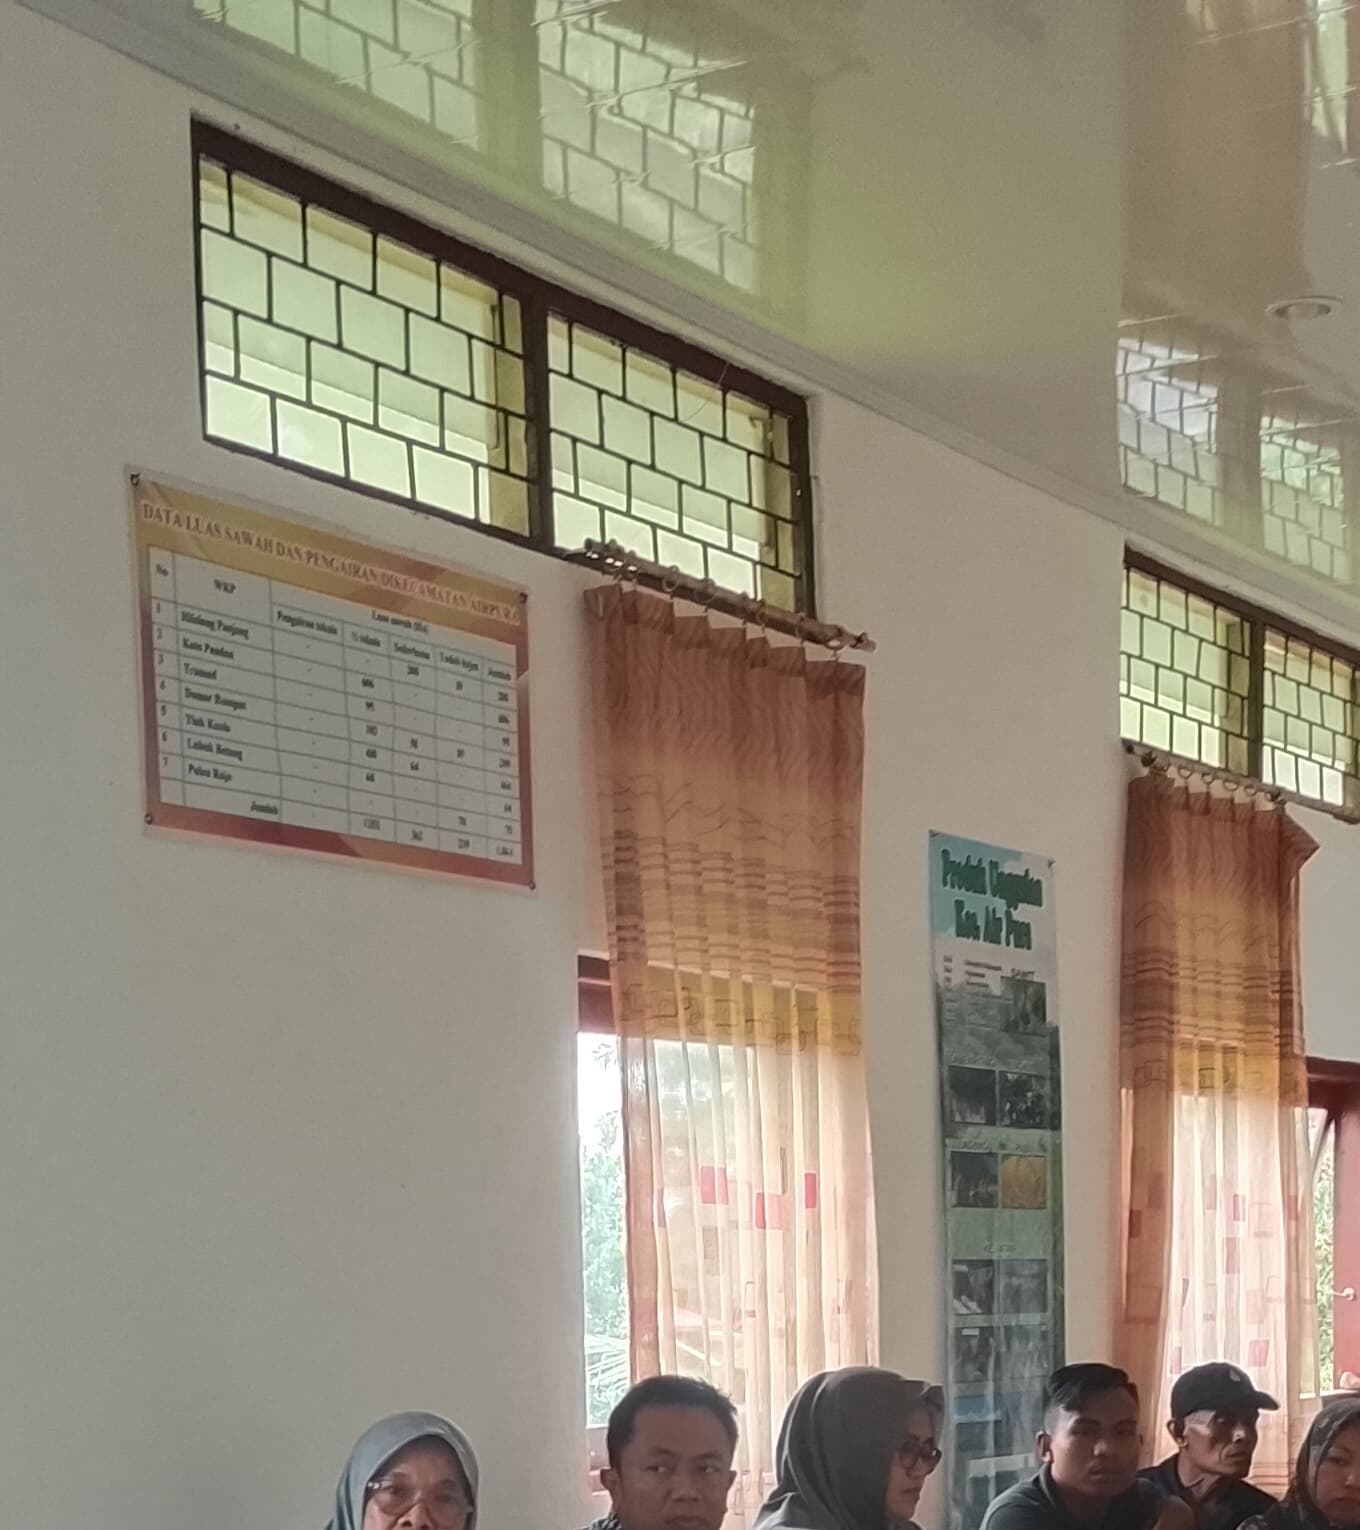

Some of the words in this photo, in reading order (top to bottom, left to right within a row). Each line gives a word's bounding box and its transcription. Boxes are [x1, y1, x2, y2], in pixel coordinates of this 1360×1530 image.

[143, 504, 183, 528] DATA
[186, 515, 222, 538] LUAS
[225, 530, 273, 554] SAWAH
[276, 541, 303, 561] DAN
[306, 550, 377, 584] PENGAIRAN
[941, 848, 987, 895] Produk
